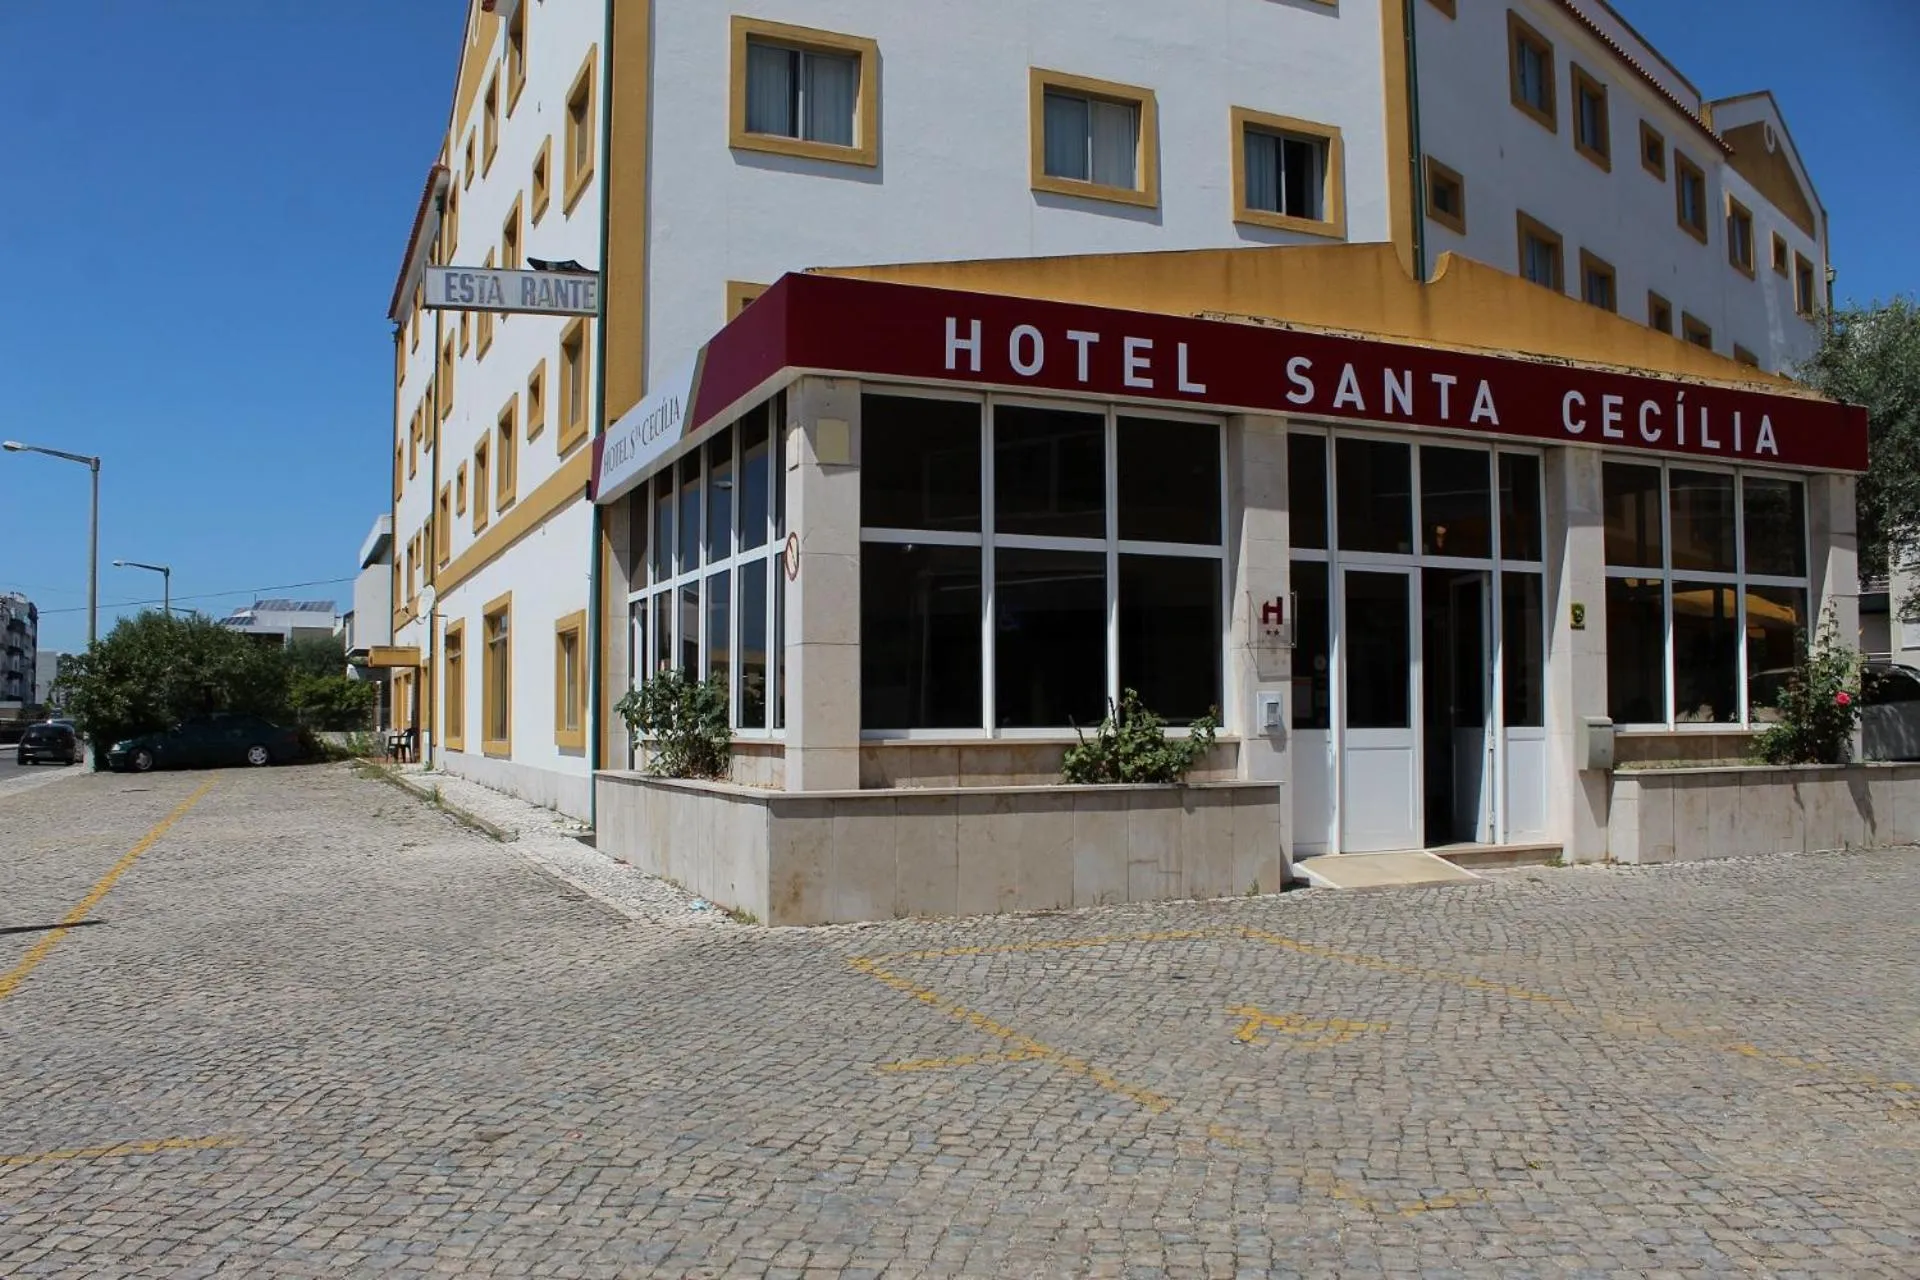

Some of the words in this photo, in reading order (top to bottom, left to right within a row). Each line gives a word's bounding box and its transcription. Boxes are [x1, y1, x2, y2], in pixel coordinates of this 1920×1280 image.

[444, 272, 505, 305] ESTA
[521, 276, 597, 310] RANTE
[945, 316, 1207, 396] HOTEL
[1285, 355, 1500, 426] SANTA
[1561, 389, 1779, 457] CECÍLIA
[603, 439, 629, 477] HOTEL
[641, 394, 681, 447] CECÍLIA
[1262, 596, 1283, 625] H
